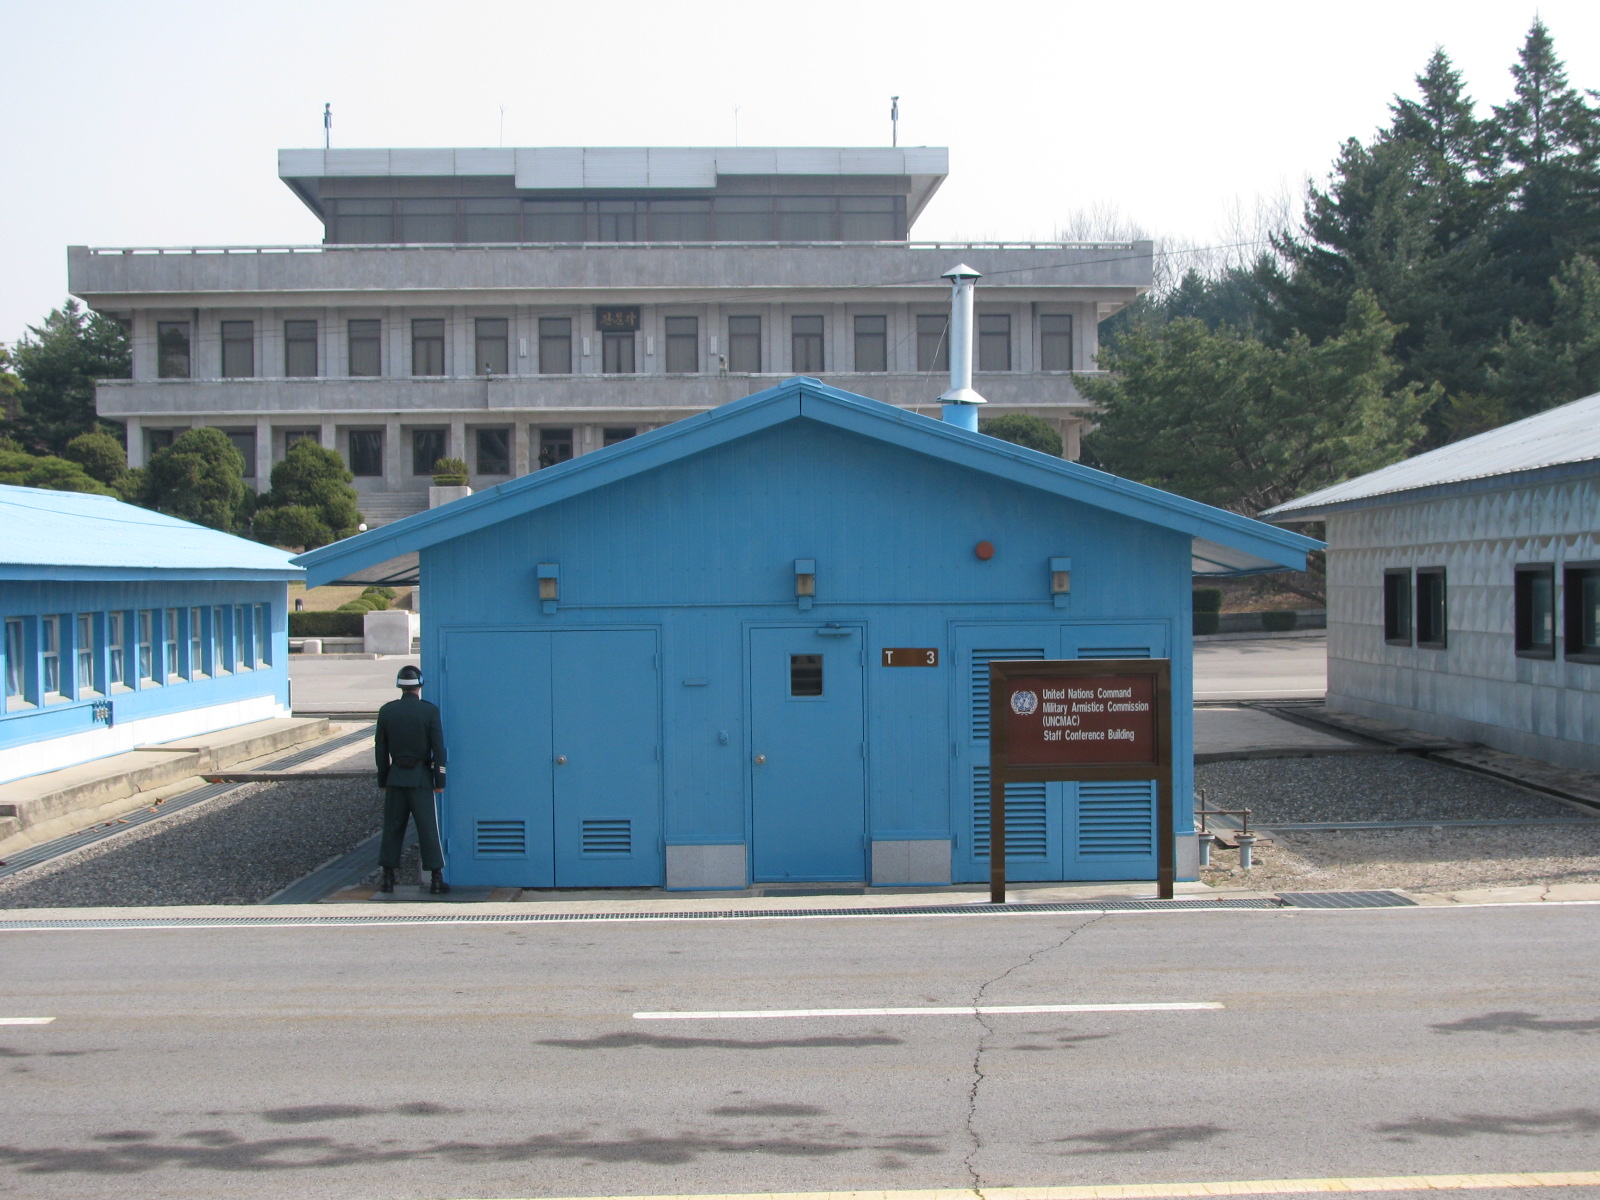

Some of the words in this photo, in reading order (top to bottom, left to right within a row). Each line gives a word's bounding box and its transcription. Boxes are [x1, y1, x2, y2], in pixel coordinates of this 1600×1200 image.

[885, 651, 894, 665] T
[926, 651, 935, 665] 3
[1042, 689, 1065, 700] United
[1067, 688, 1094, 699] Nations
[1097, 687, 1132, 699] Command
[1042, 702, 1068, 715] Military
[1071, 702, 1104, 713] Armistice
[1107, 701, 1149, 712] Commission
[1042, 715, 1080, 727] (UNCMAC)
[1043, 730, 1062, 741] Staff
[1065, 730, 1105, 741] Conference
[1107, 729, 1135, 742] Building
